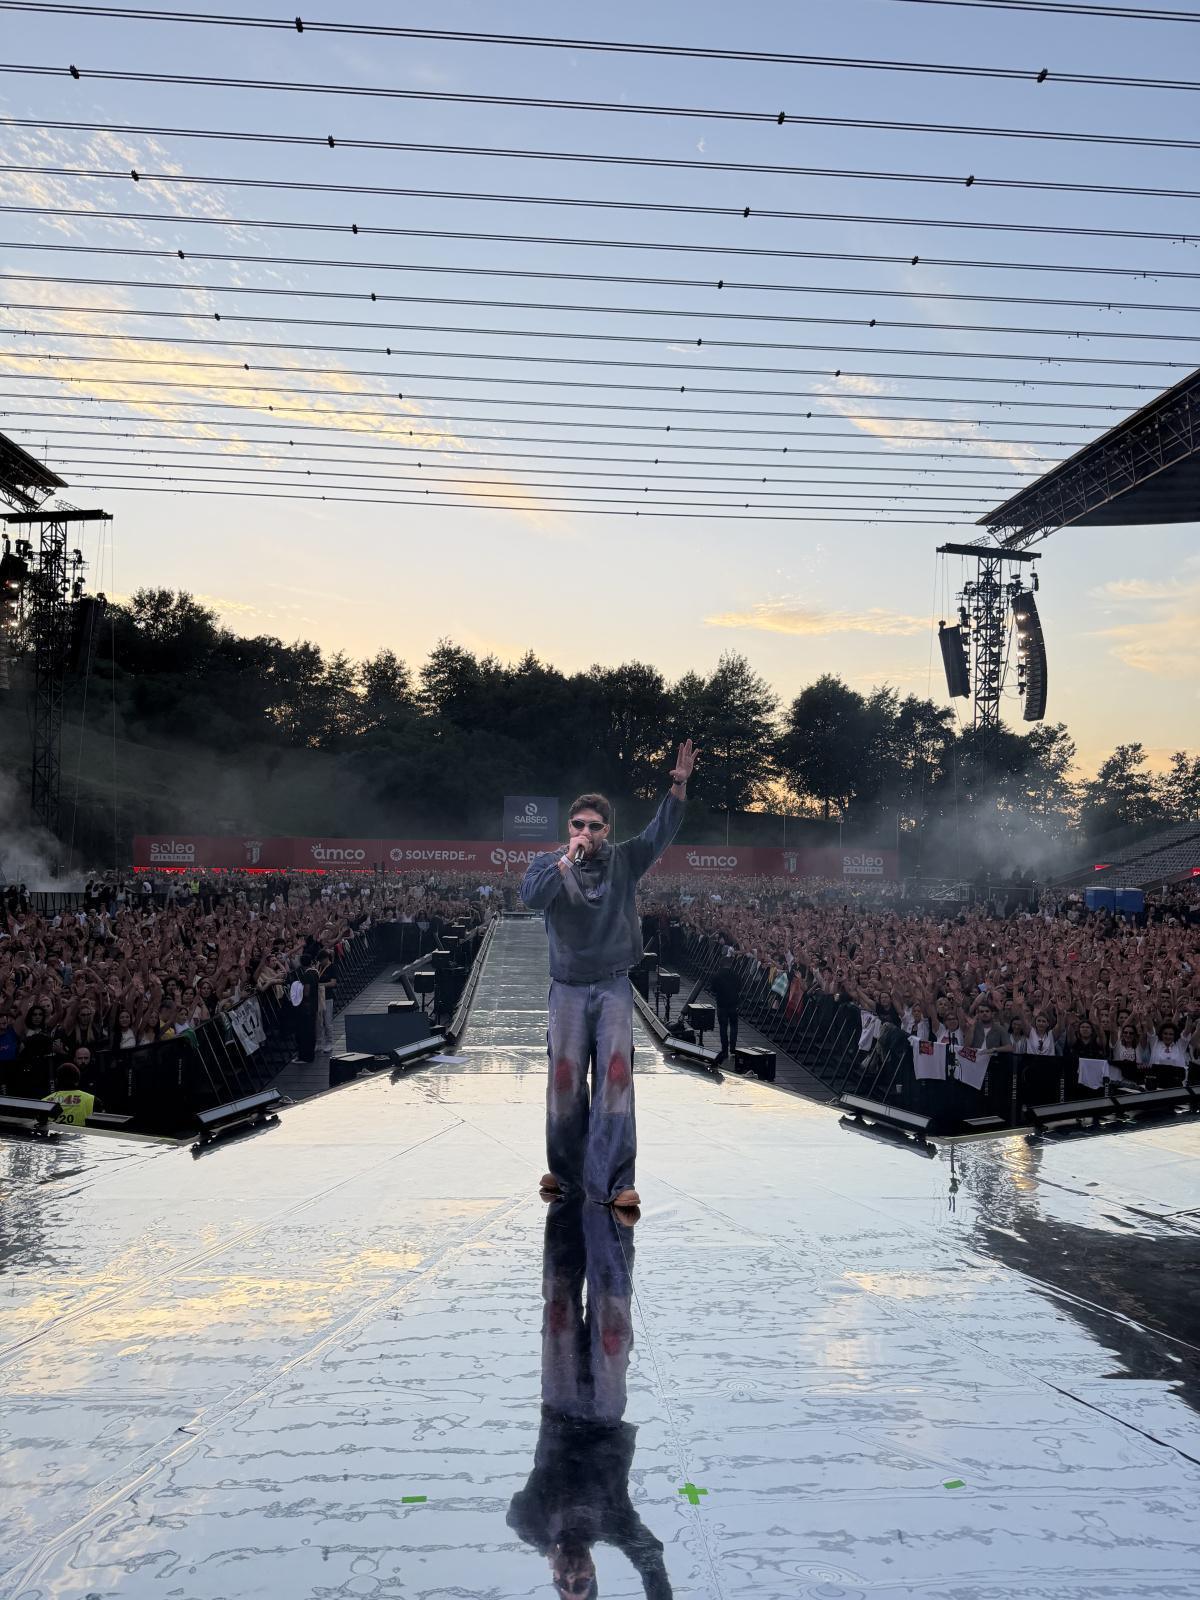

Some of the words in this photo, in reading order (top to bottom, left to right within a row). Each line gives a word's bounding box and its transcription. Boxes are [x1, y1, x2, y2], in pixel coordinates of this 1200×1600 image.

[514, 815, 548, 825] SABSEG
[150, 840, 195, 854] soleo
[313, 848, 366, 860] amco
[405, 850, 477, 861] SOLVERDE.PT
[843, 854, 884, 866] soleo
[688, 855, 738, 867] amco
